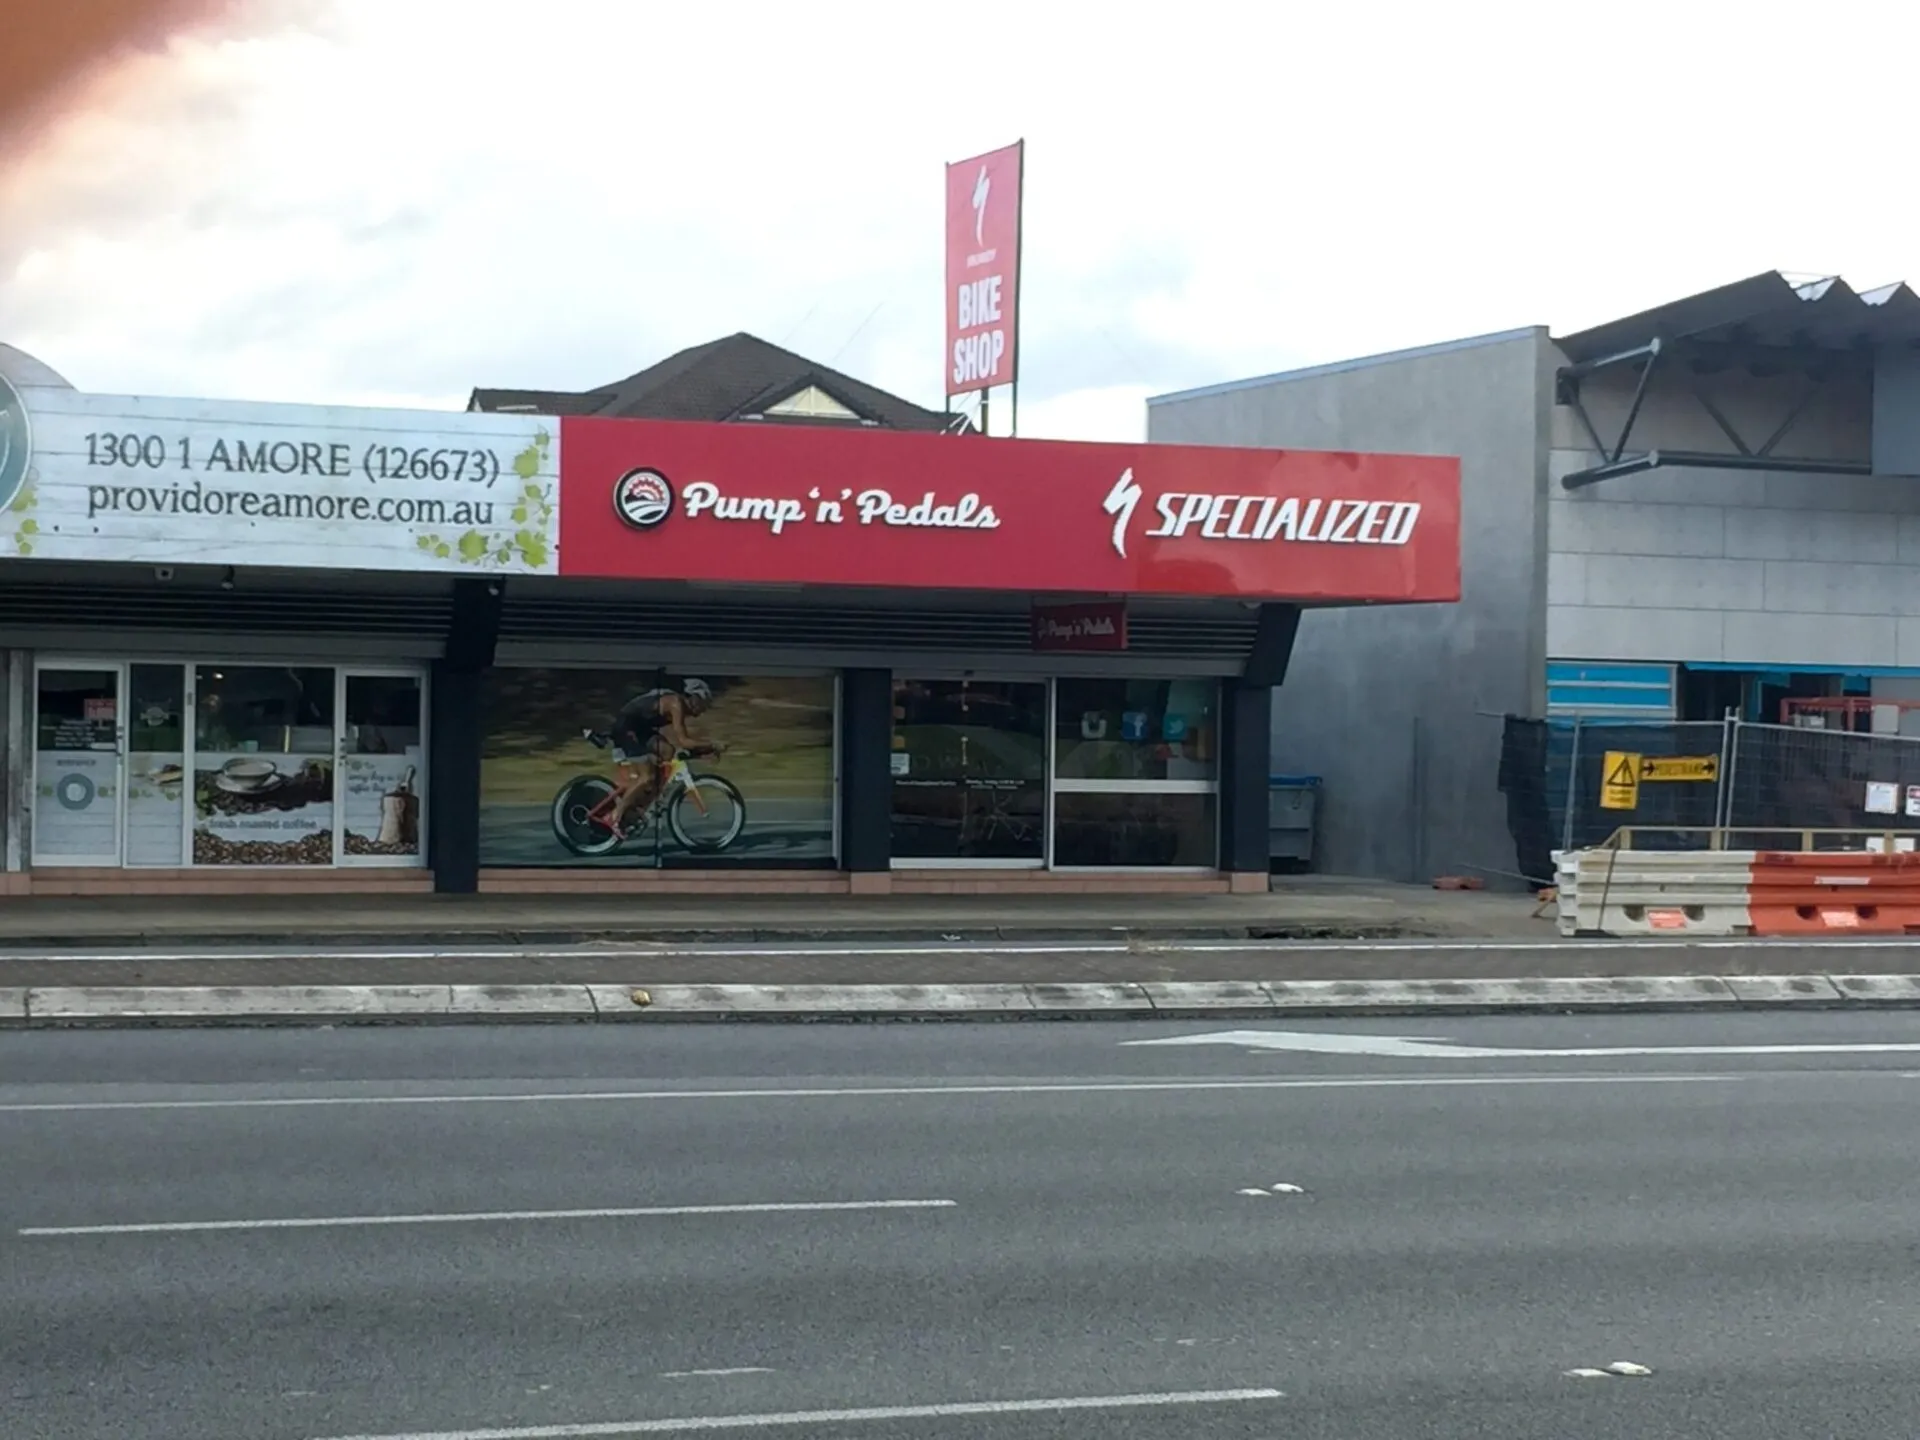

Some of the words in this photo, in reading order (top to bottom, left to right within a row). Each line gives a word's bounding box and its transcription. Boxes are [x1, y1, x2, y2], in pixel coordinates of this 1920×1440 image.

[958, 275, 1002, 330] BIKE
[953, 330, 1005, 385] SHOP
[84, 432, 166, 469] 1300
[178, 436, 192, 470] 1
[204, 438, 352, 477] AMORE
[363, 443, 500, 489] (126673)
[87, 481, 494, 526] providoreamore.com.au
[682, 481, 806, 535] Pump
[856, 488, 1001, 529] Pedals
[1145, 492, 1421, 545] SPECIALIZED
